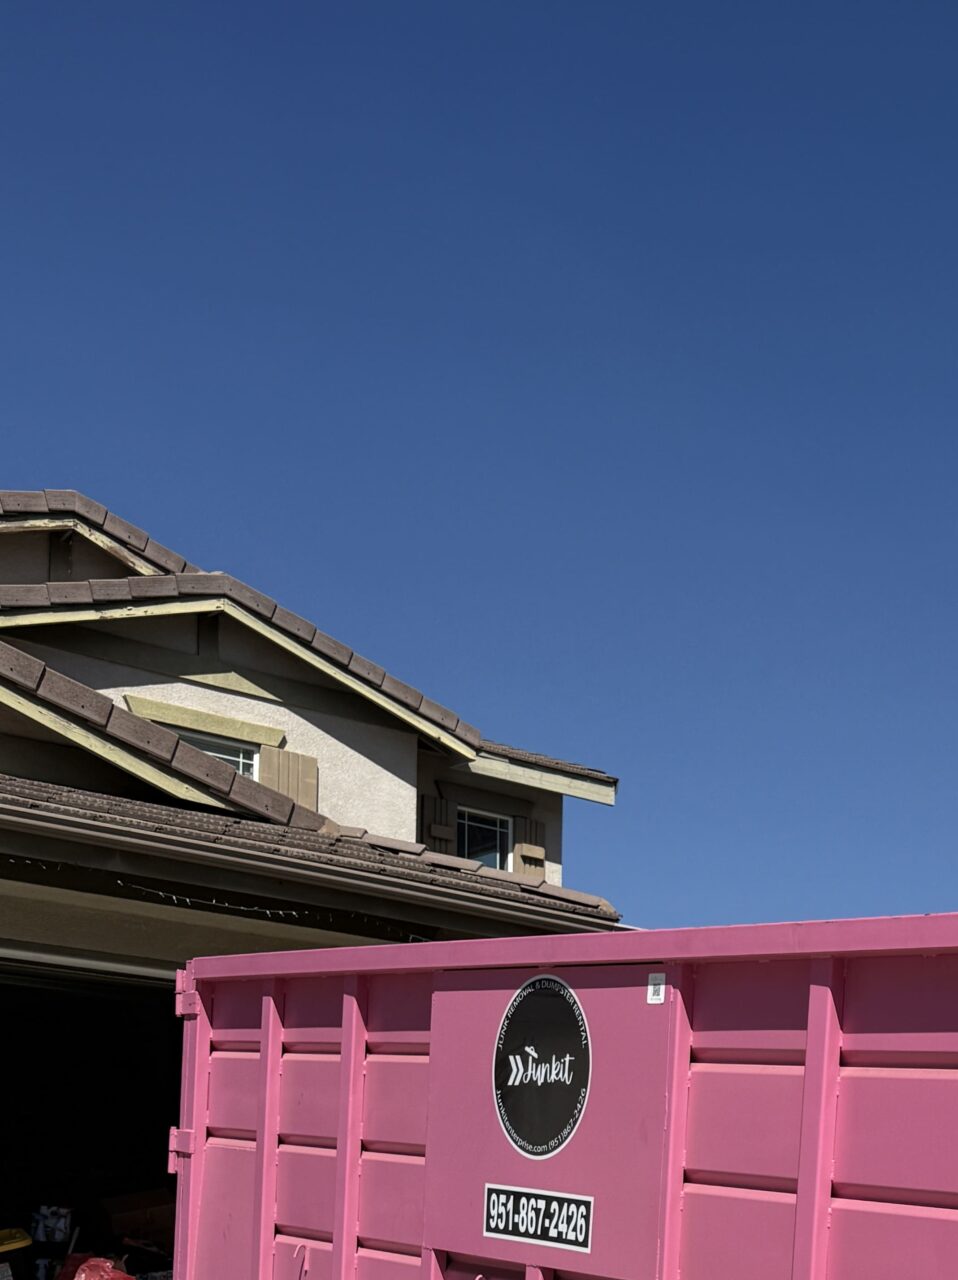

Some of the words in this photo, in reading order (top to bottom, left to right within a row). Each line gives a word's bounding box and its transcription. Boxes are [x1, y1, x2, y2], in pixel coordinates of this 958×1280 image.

[498, 1018, 511, 1051] JUNK
[507, 984, 535, 1018] REMOVAL
[541, 980, 575, 1004] DUMPSTER
[572, 1003, 589, 1049] RENTAL
[522, 1053, 576, 1087] Junkit
[548, 1088, 587, 1150] (951)867-2426
[489, 1193, 587, 1243] 951-867-2426
